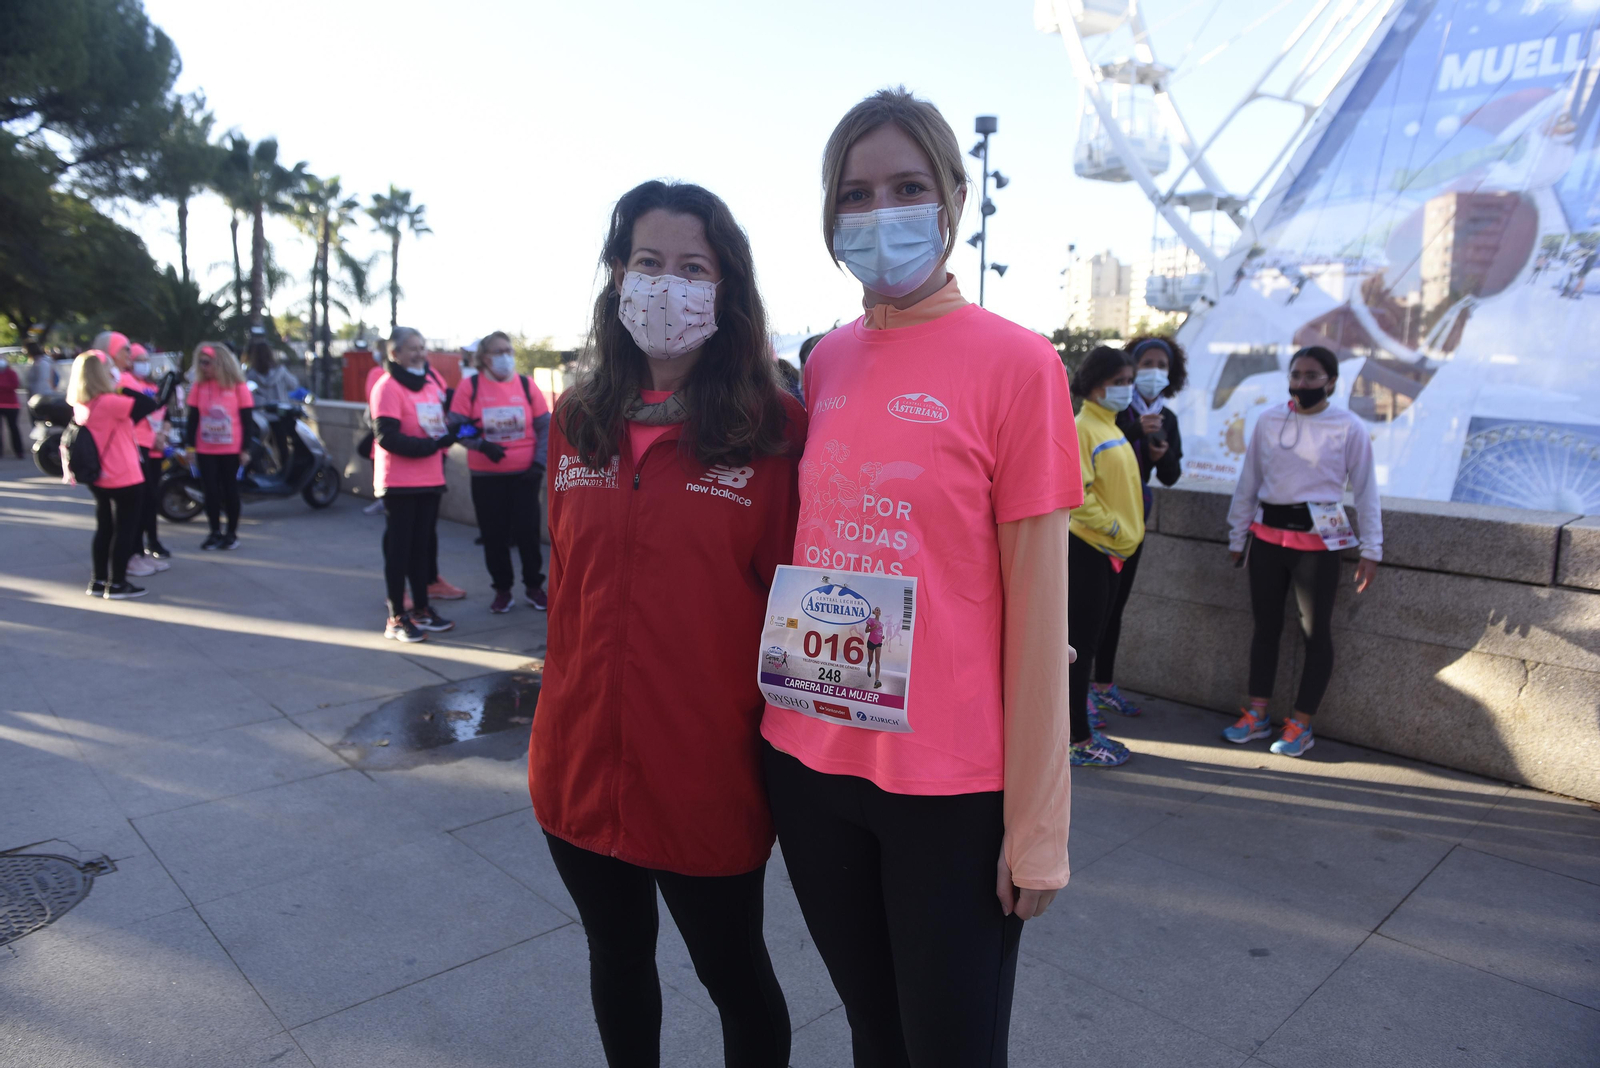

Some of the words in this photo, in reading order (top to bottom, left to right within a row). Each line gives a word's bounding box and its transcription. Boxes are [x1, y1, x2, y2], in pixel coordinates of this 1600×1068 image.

[685, 481, 710, 495] new
[710, 485, 752, 508] balance
[862, 494, 912, 521] POR
[834, 519, 908, 551] TODAS
[803, 545, 904, 576] OSOTRAS
[805, 596, 866, 618] ASTURIANA
[815, 595, 838, 603] CENTRAL
[803, 630, 865, 665] 016
[817, 667, 842, 683] 248
[767, 692, 809, 710] OYSHO
[784, 677, 821, 693] CARRERA
[822, 684, 834, 694] DE
[835, 687, 847, 697] LA
[848, 689, 880, 703] MUJER
[824, 706, 846, 715] Santander
[869, 715, 899, 726] ZURICH
